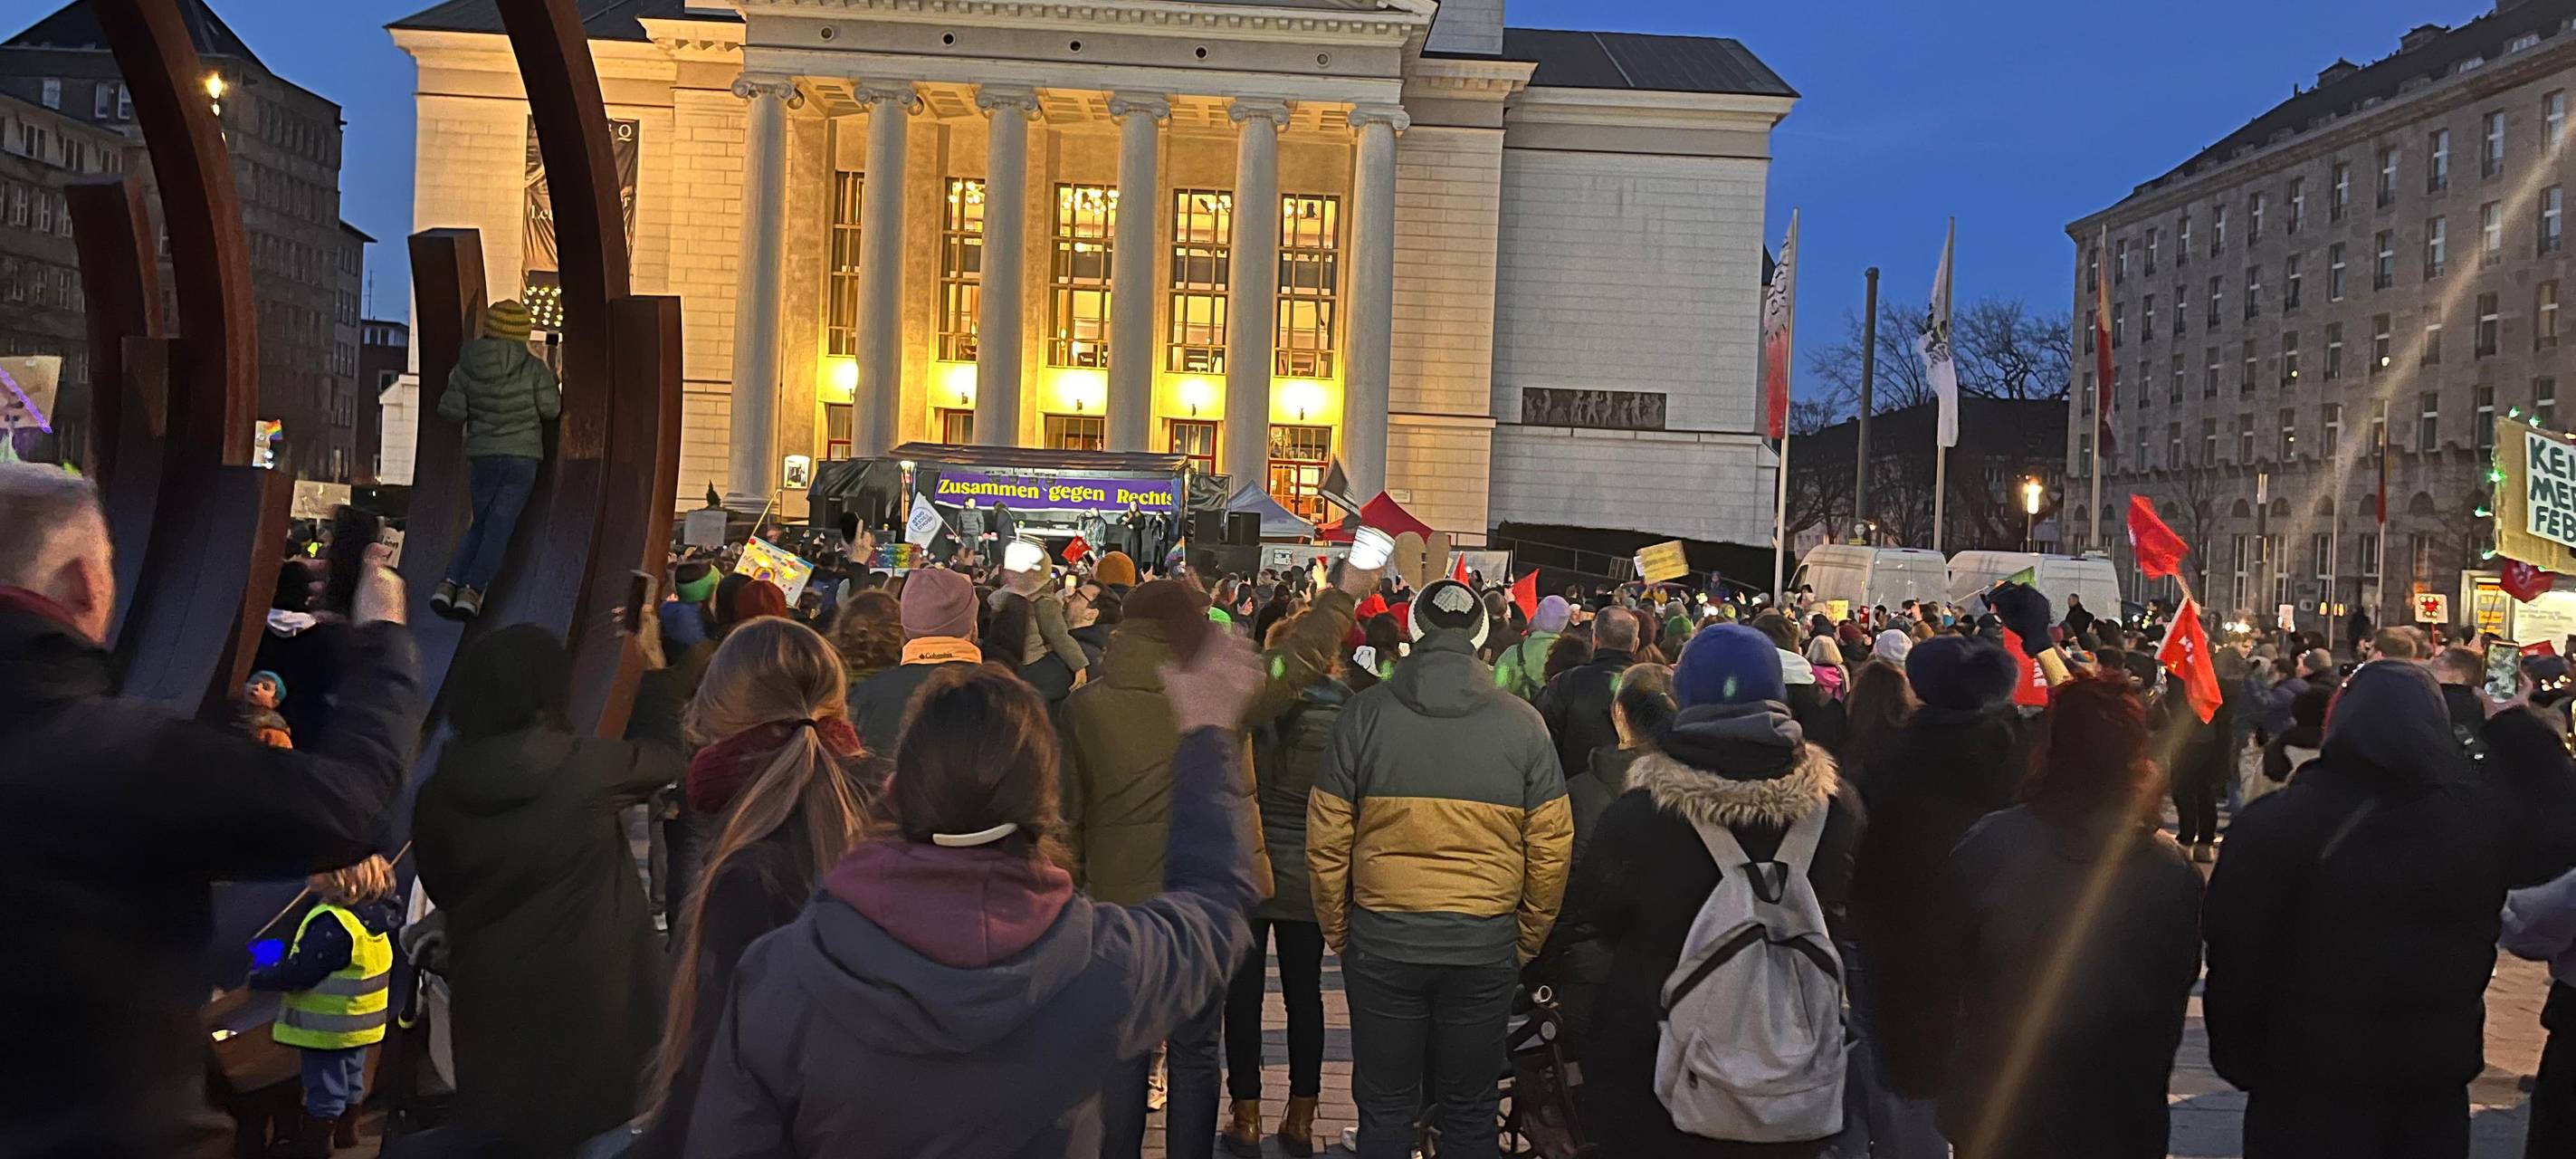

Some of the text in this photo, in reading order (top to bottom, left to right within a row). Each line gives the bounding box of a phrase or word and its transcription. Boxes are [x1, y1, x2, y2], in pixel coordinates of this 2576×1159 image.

[938, 479, 1172, 505] Zusammen gegen Rechts
